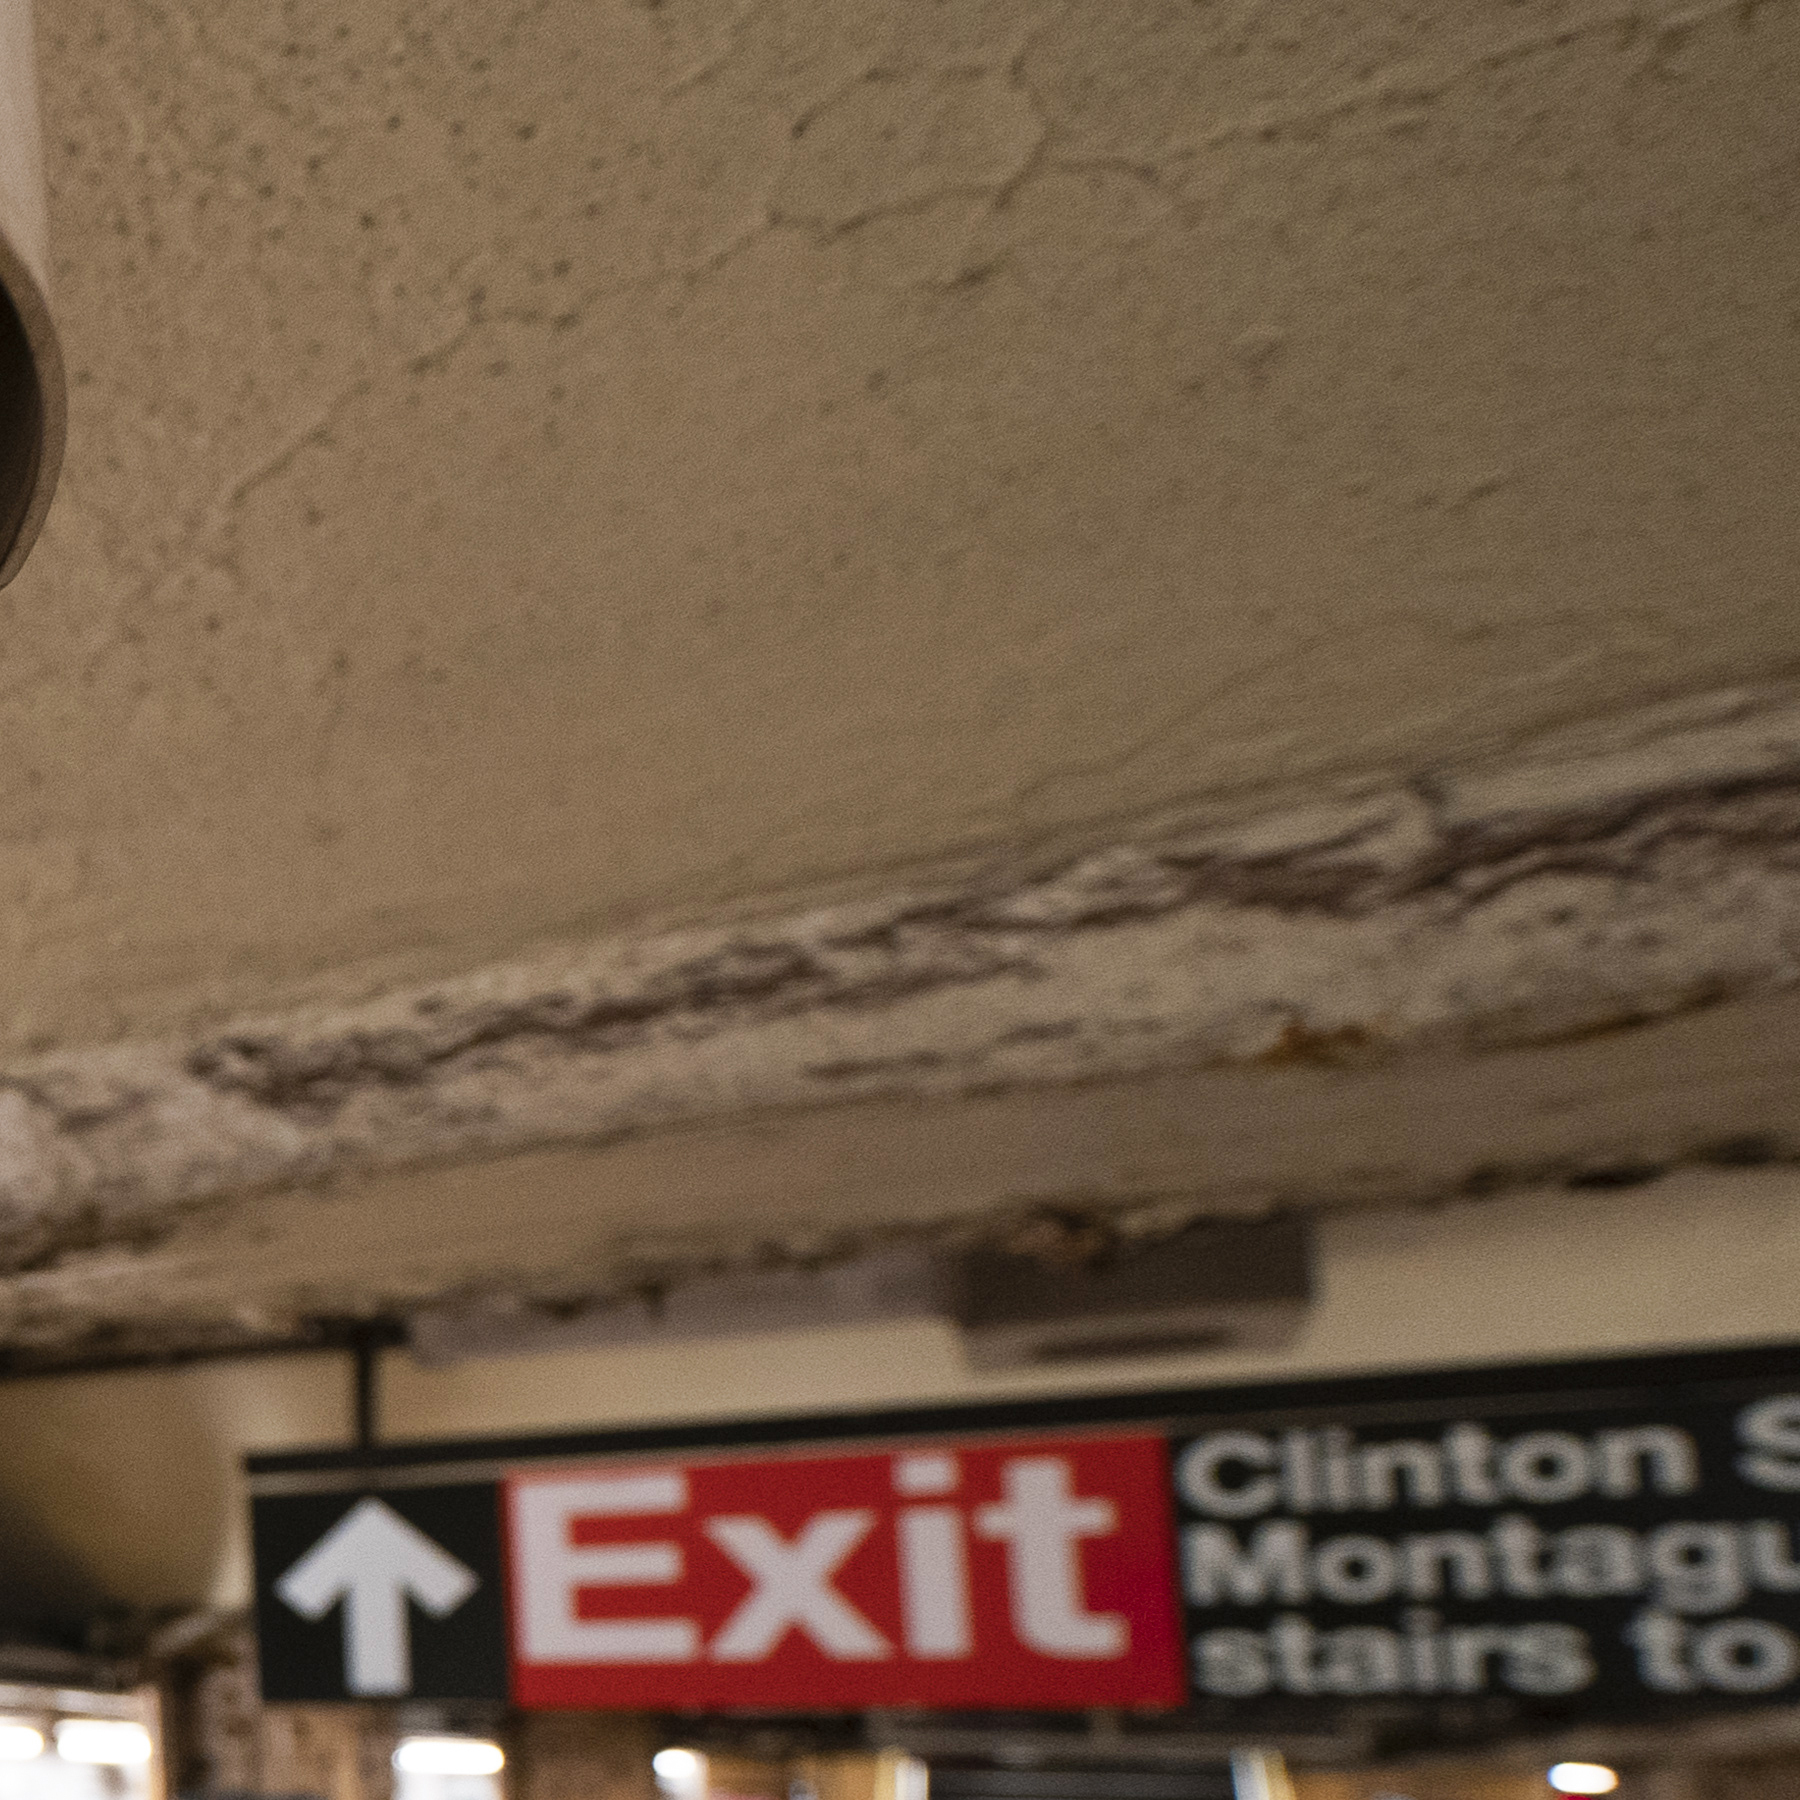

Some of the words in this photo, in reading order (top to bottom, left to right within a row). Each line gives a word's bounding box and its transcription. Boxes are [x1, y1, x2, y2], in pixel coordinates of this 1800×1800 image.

[1174, 1419, 1701, 1520] Clinton
[1732, 1392, 1800, 1494] S
[507, 1448, 1133, 1665] Exit
[1179, 1511, 1800, 1614] Montagu
[1189, 1606, 1599, 1696] stairs
[1621, 1605, 1800, 1694] to
